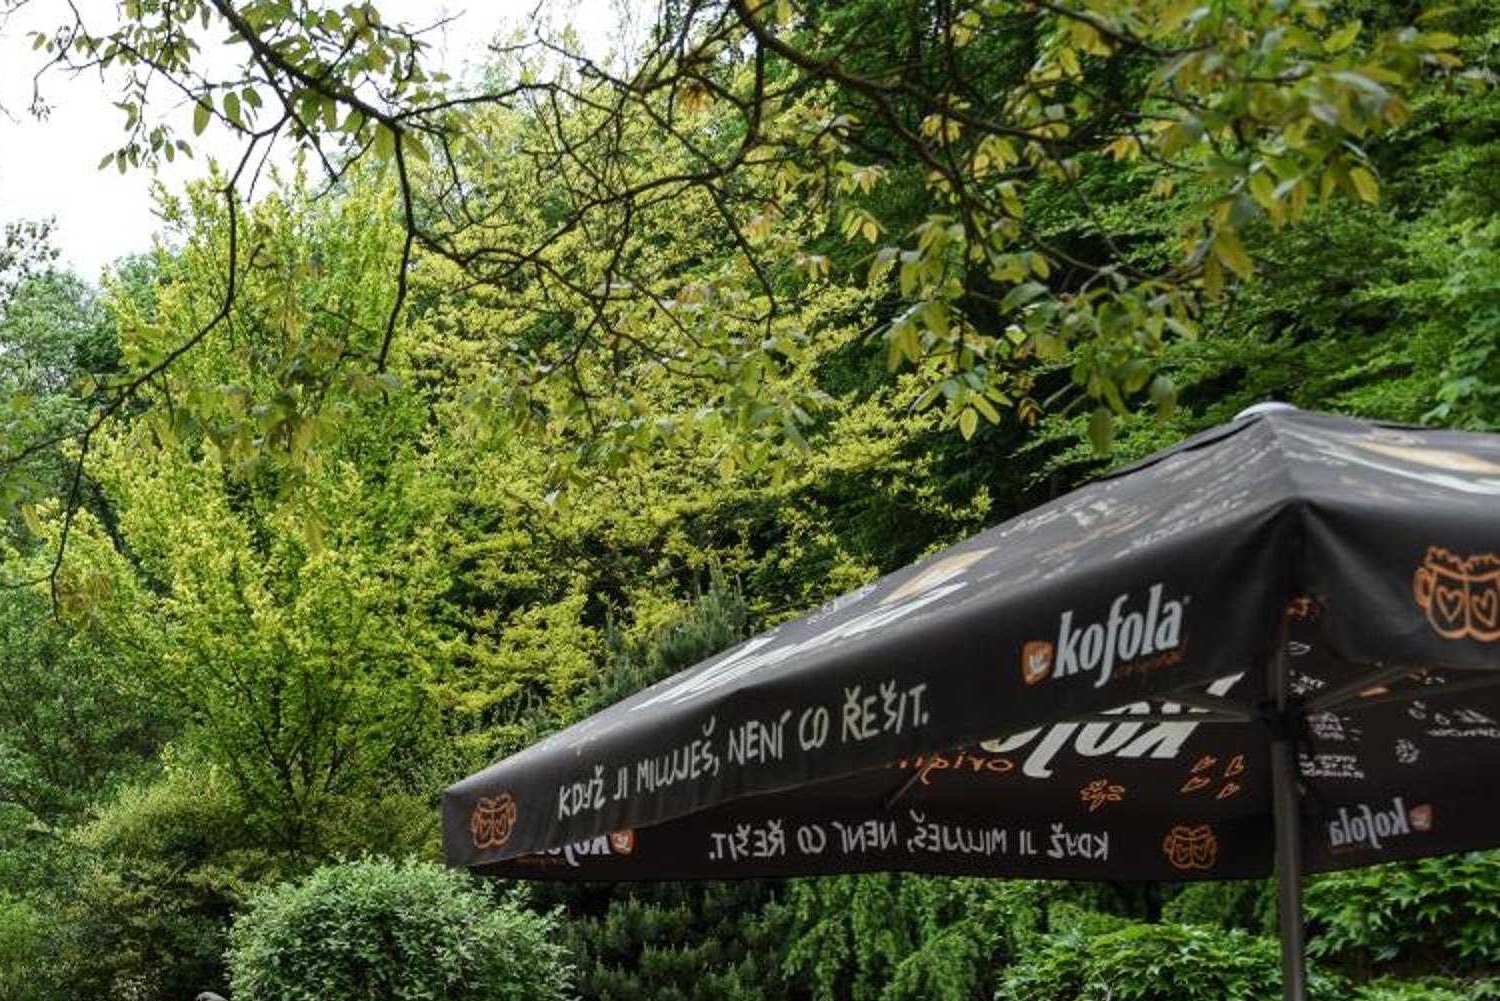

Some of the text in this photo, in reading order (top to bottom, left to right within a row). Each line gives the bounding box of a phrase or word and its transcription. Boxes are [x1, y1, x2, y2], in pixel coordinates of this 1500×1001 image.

[1052, 583, 1183, 689] kofola
[557, 680, 930, 820] KDYŽ JI MILUJEŠ, NENÍ CO ŘEŠIT.
